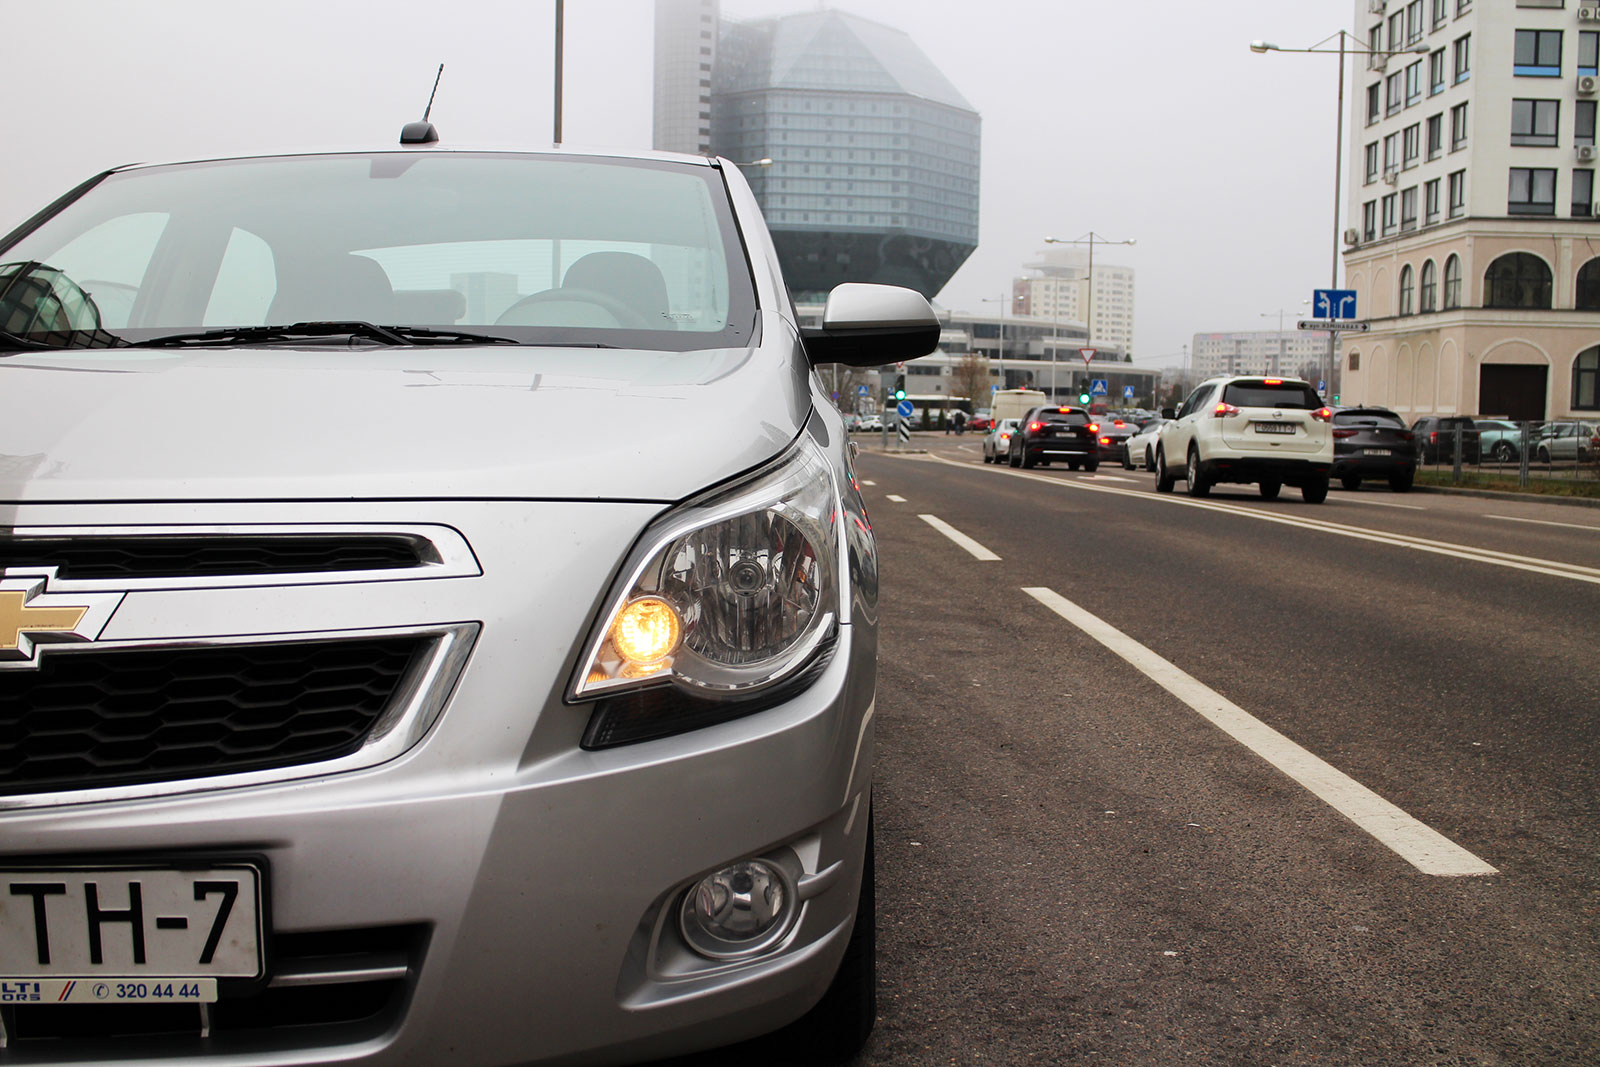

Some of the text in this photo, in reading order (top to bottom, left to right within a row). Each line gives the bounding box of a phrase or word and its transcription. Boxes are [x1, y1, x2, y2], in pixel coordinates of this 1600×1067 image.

[9, 880, 239, 964] TH-7
[116, 983, 147, 998] 320
[152, 983, 174, 998] 44
[179, 983, 200, 998] 44
